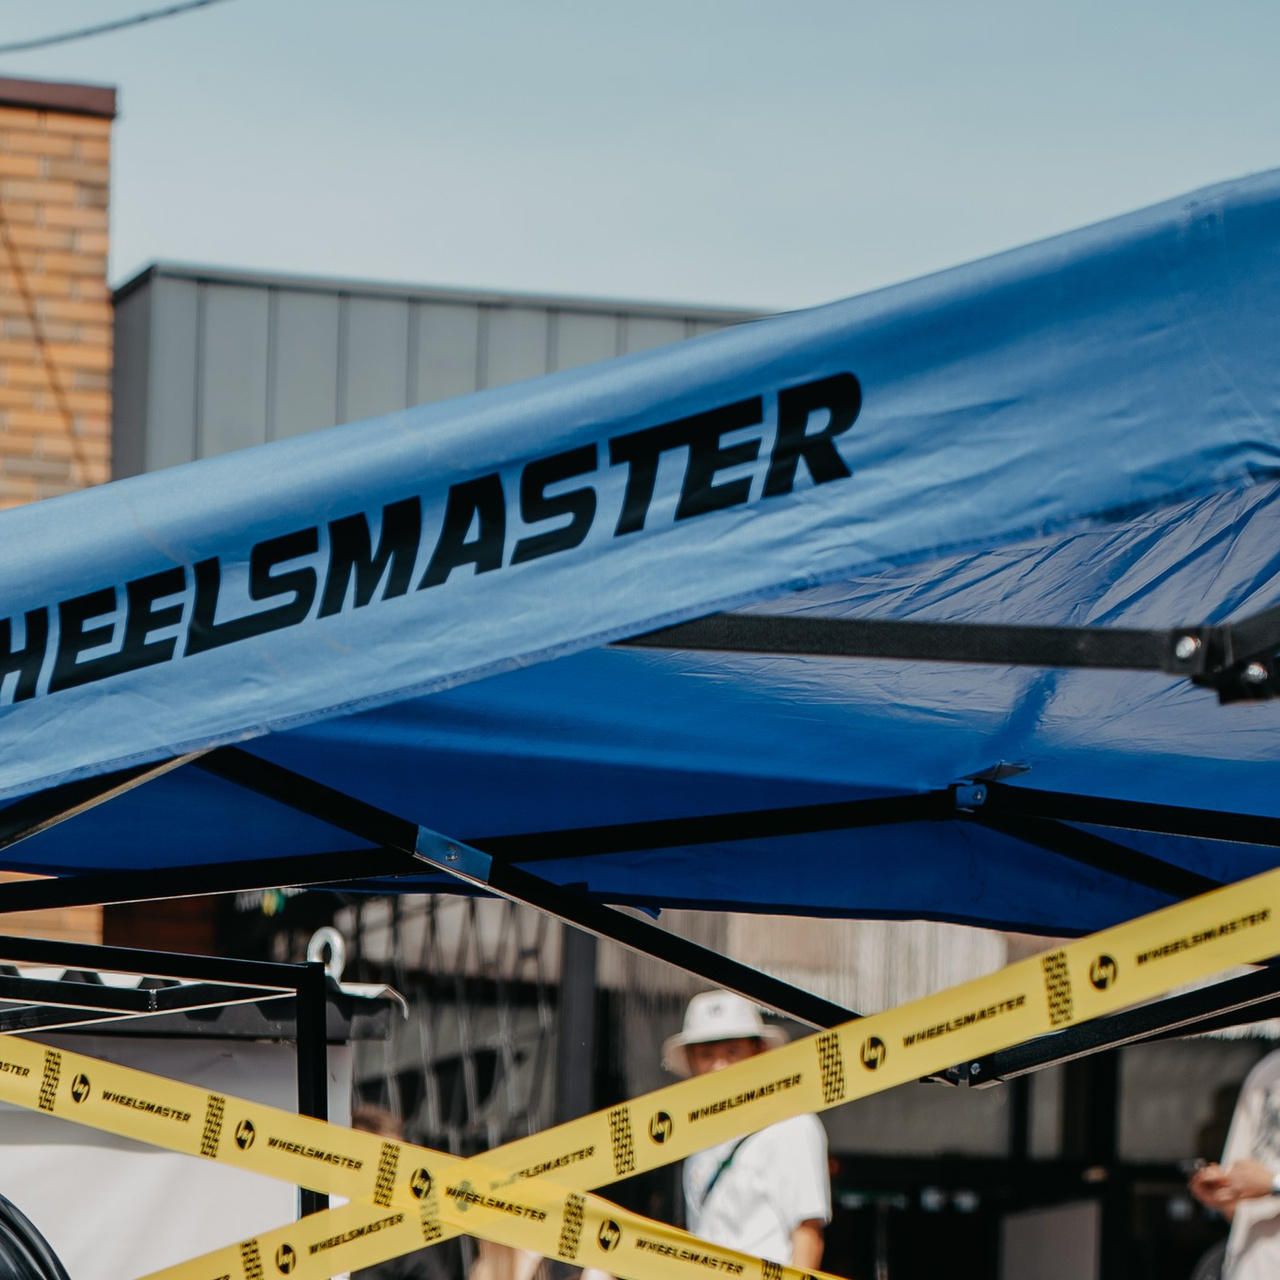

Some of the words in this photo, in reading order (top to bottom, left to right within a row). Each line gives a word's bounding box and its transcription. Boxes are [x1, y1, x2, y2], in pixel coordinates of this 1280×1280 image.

[902, 995, 1027, 1048] WHEELSMASTER
[102, 1089, 191, 1123] WHEELSMASTER
[688, 1073, 804, 1123] WHEELSMASTER
[267, 1135, 364, 1172] WHEELSMASTER
[308, 1212, 405, 1255] WHEELSMASTER
[635, 1238, 745, 1276] WHEELSMASTER
